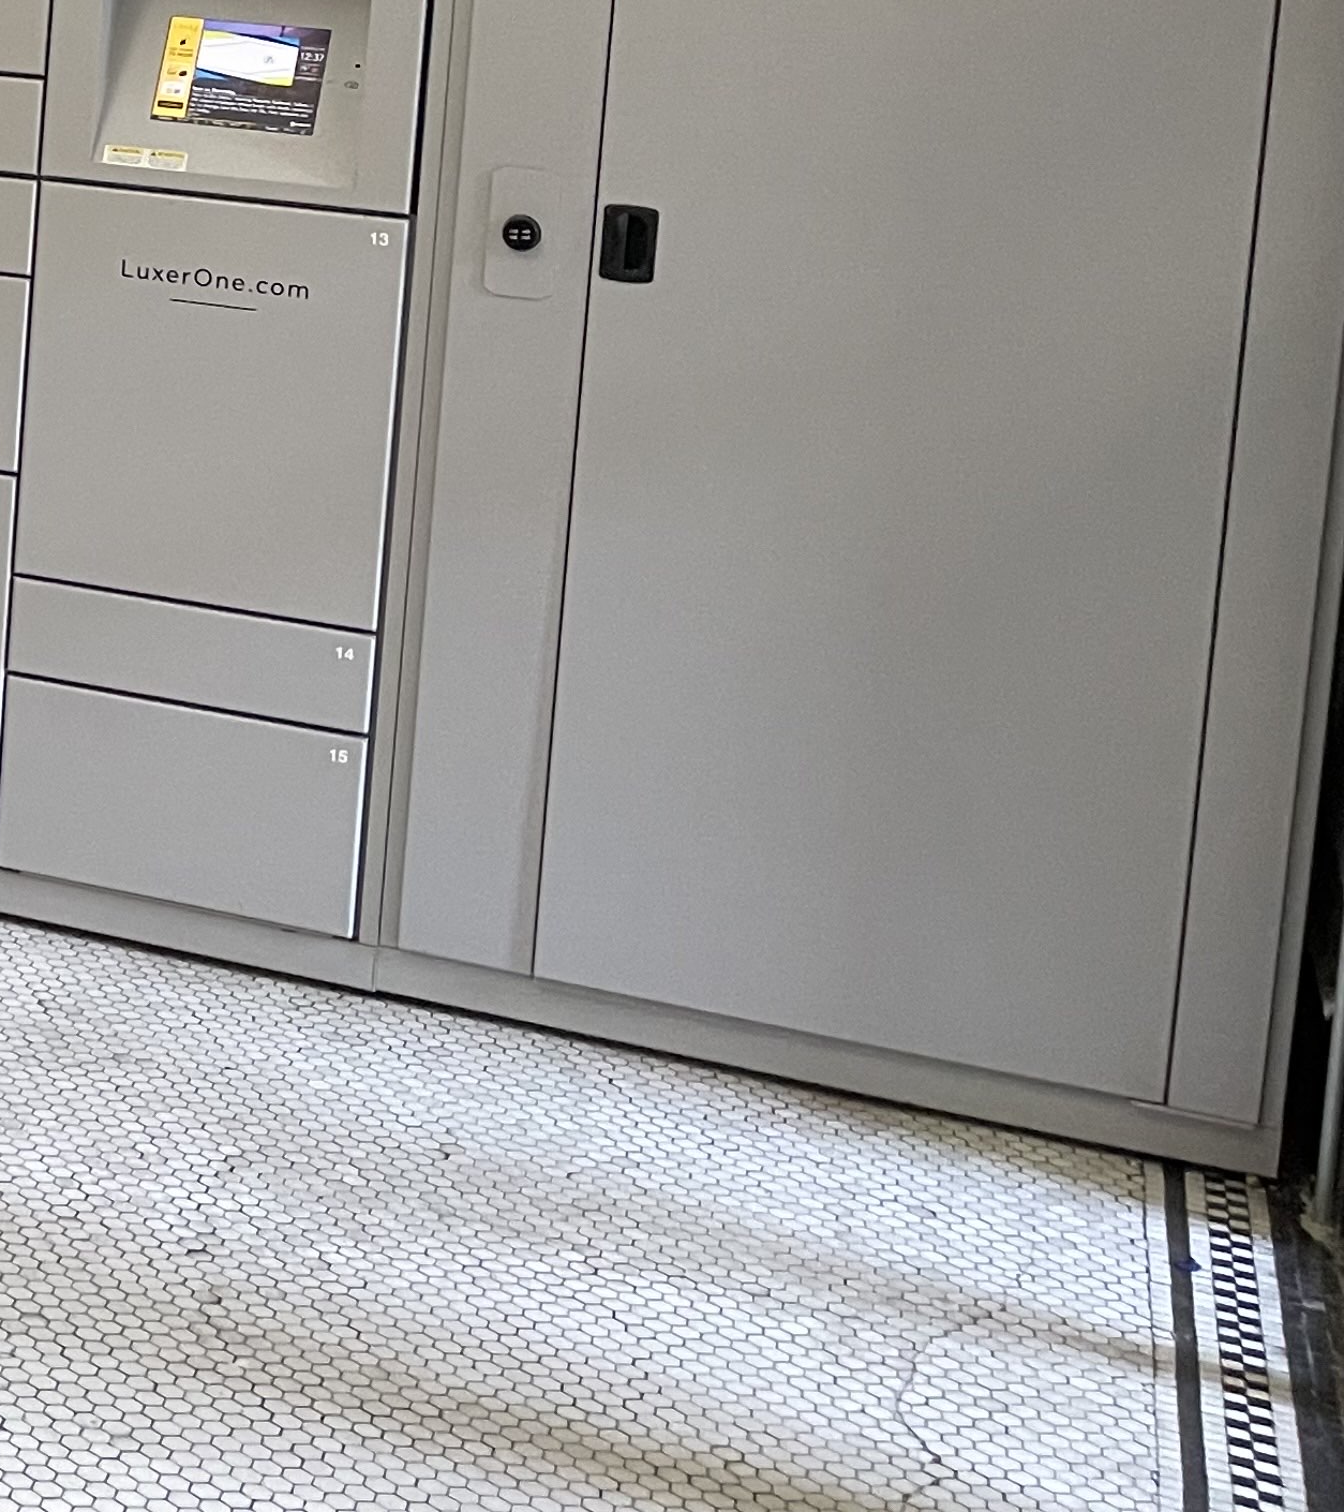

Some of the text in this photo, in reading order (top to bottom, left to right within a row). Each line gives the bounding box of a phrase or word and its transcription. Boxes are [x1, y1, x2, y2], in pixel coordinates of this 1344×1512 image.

[300, 52, 325, 62] 12:37
[370, 231, 389, 247] 13
[120, 258, 310, 300] LuxerOne.com
[335, 646, 355, 661] 14
[329, 748, 349, 764] 15
